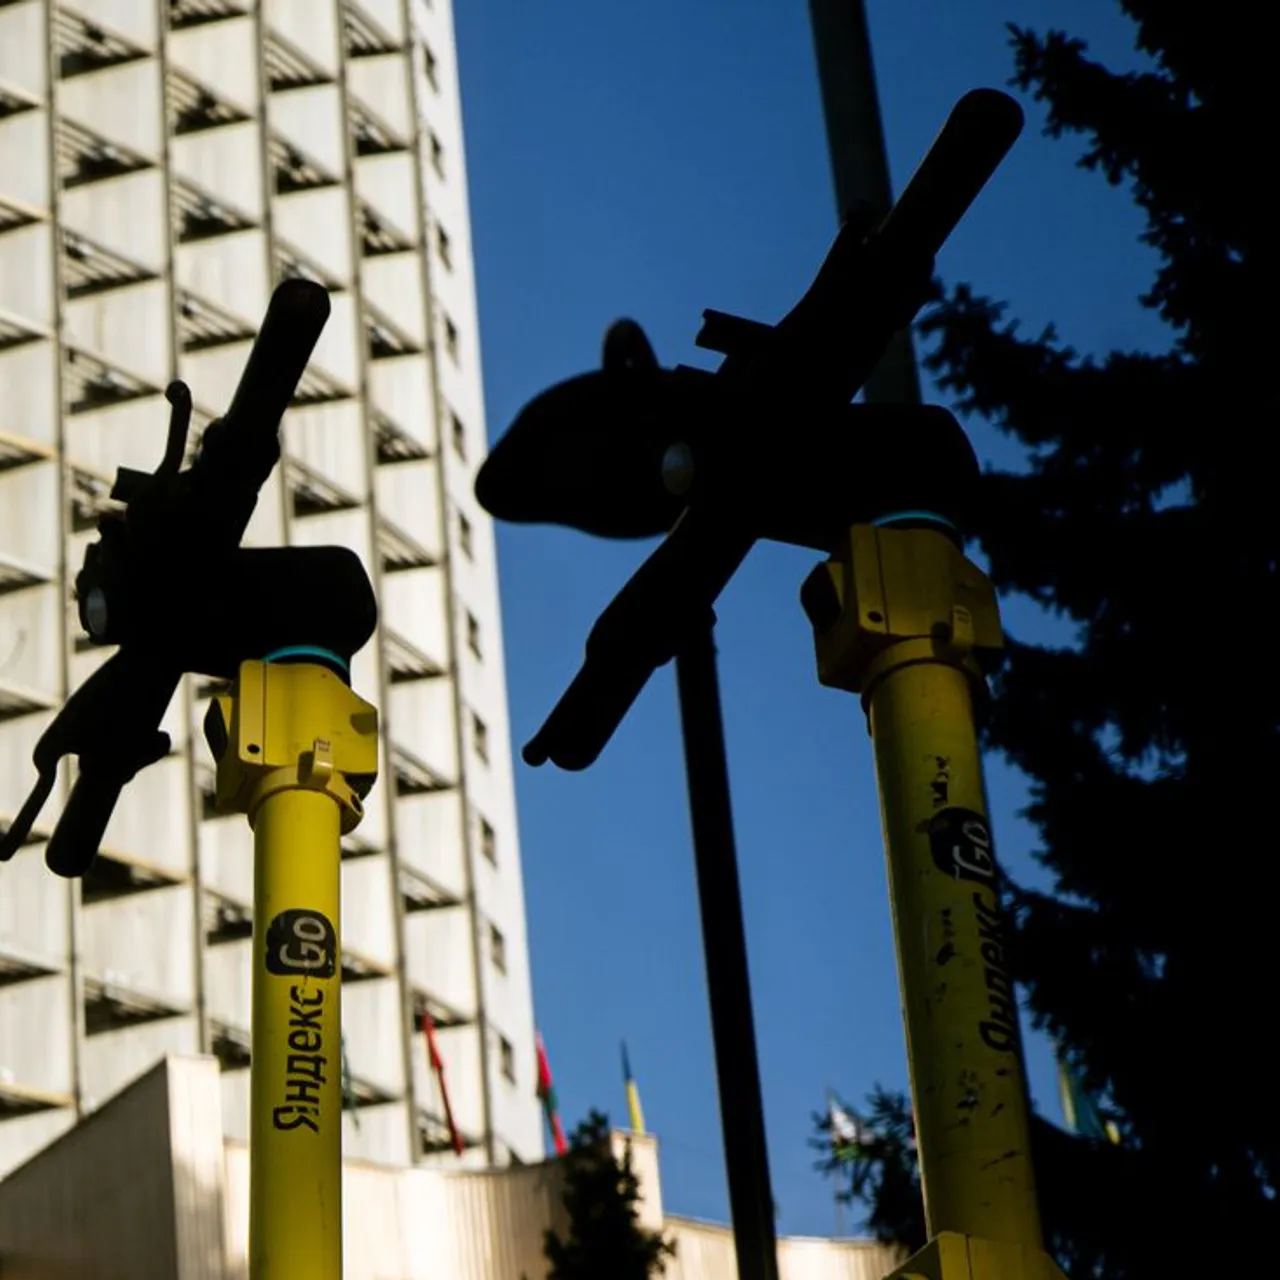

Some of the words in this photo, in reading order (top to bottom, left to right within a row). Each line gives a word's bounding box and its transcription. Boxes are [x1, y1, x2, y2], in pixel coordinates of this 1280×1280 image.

[951, 819, 995, 879] Go
[279, 915, 327, 969] Go
[272, 985, 327, 1132] Яндекс
